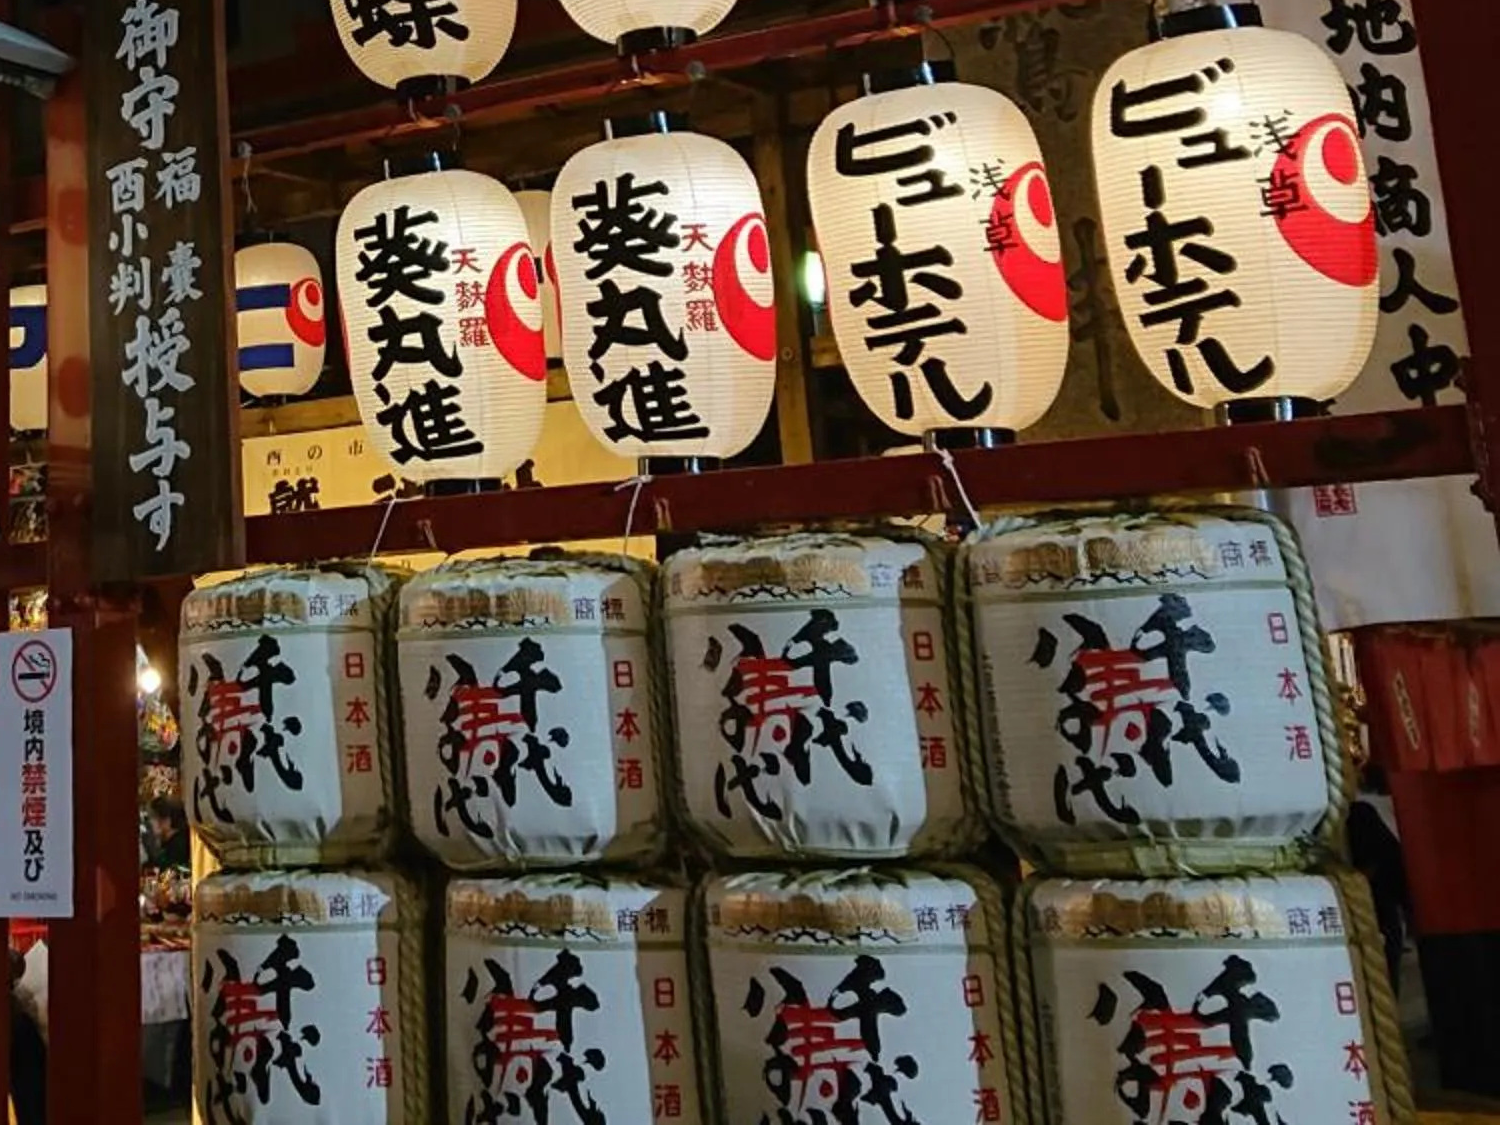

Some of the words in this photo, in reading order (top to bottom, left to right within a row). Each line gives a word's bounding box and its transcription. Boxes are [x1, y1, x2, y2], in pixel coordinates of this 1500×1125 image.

[970, 157, 1015, 254] 浅草
[1109, 56, 1275, 395] ビューホテル
[1250, 109, 1309, 223] 浅草
[354, 205, 483, 466] 葵丸進
[572, 173, 710, 443] 葵丸進
[835, 110, 994, 423] ビューホテル
[121, 306, 197, 551] 授与す
[344, 652, 373, 775] 日本酒
[613, 659, 645, 791] 日本酒
[913, 630, 948, 771] 日本酒
[1267, 612, 1313, 761] 日本酒
[21, 709, 47, 882] 境内禁煙及び
[365, 957, 393, 1090] 日本酒
[653, 978, 681, 1119] 日本酒
[963, 976, 999, 1123] 日本酒
